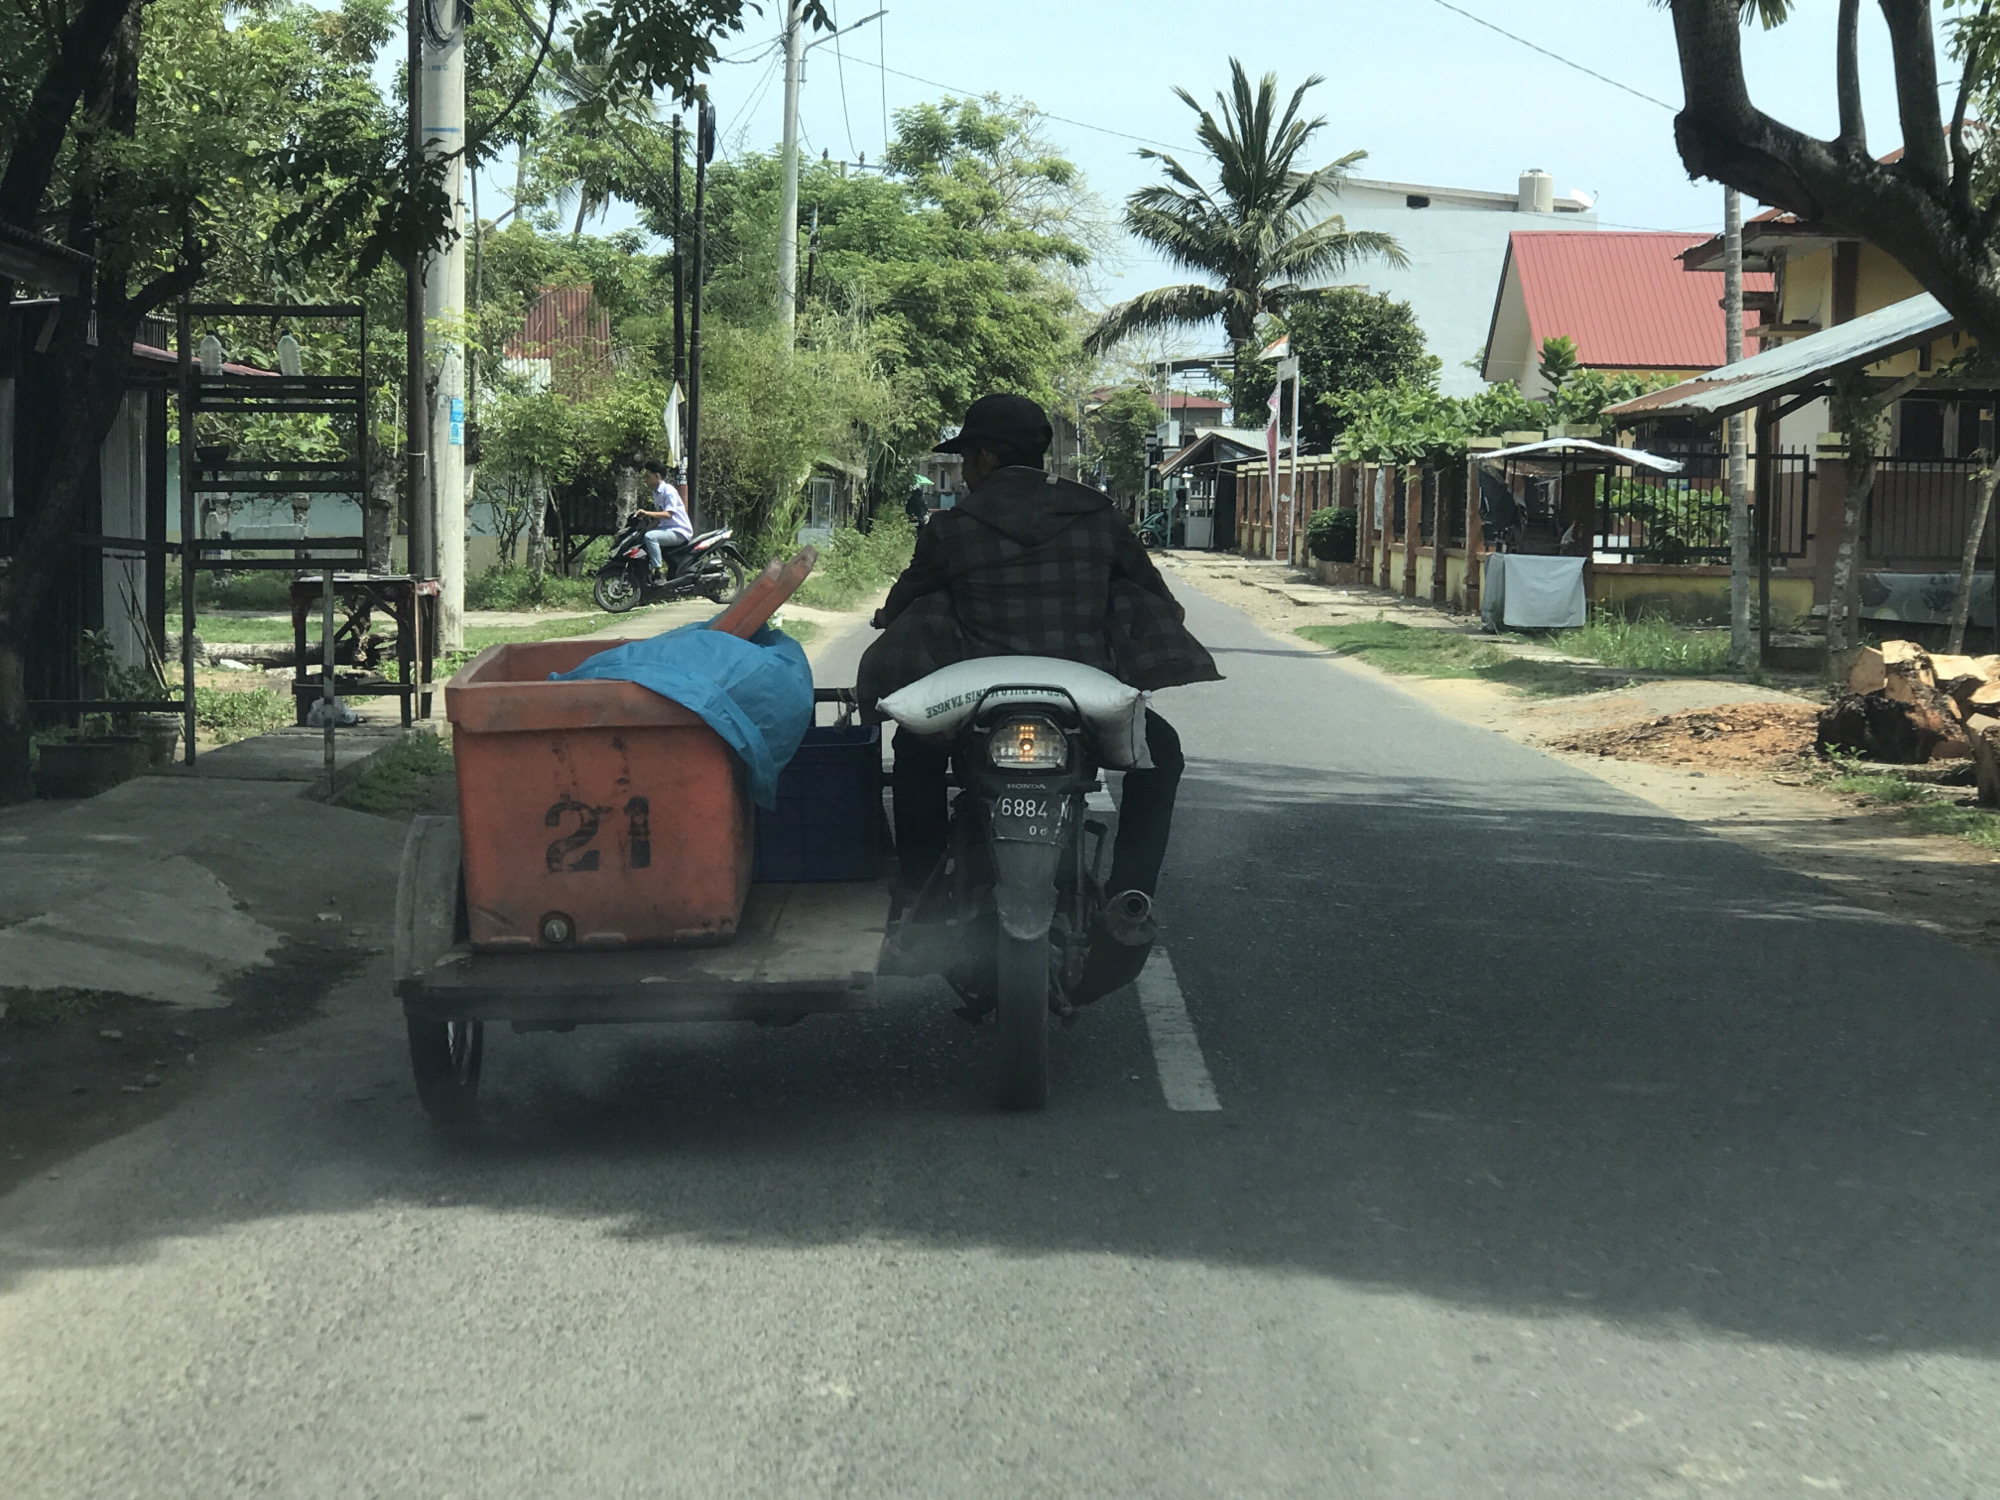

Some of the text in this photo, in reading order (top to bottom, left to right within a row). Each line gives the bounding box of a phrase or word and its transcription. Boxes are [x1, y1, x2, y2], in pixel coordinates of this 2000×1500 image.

[925, 695, 964, 719] TANGSE
[1002, 797, 1048, 819] 6884
[544, 795, 652, 874] 21
